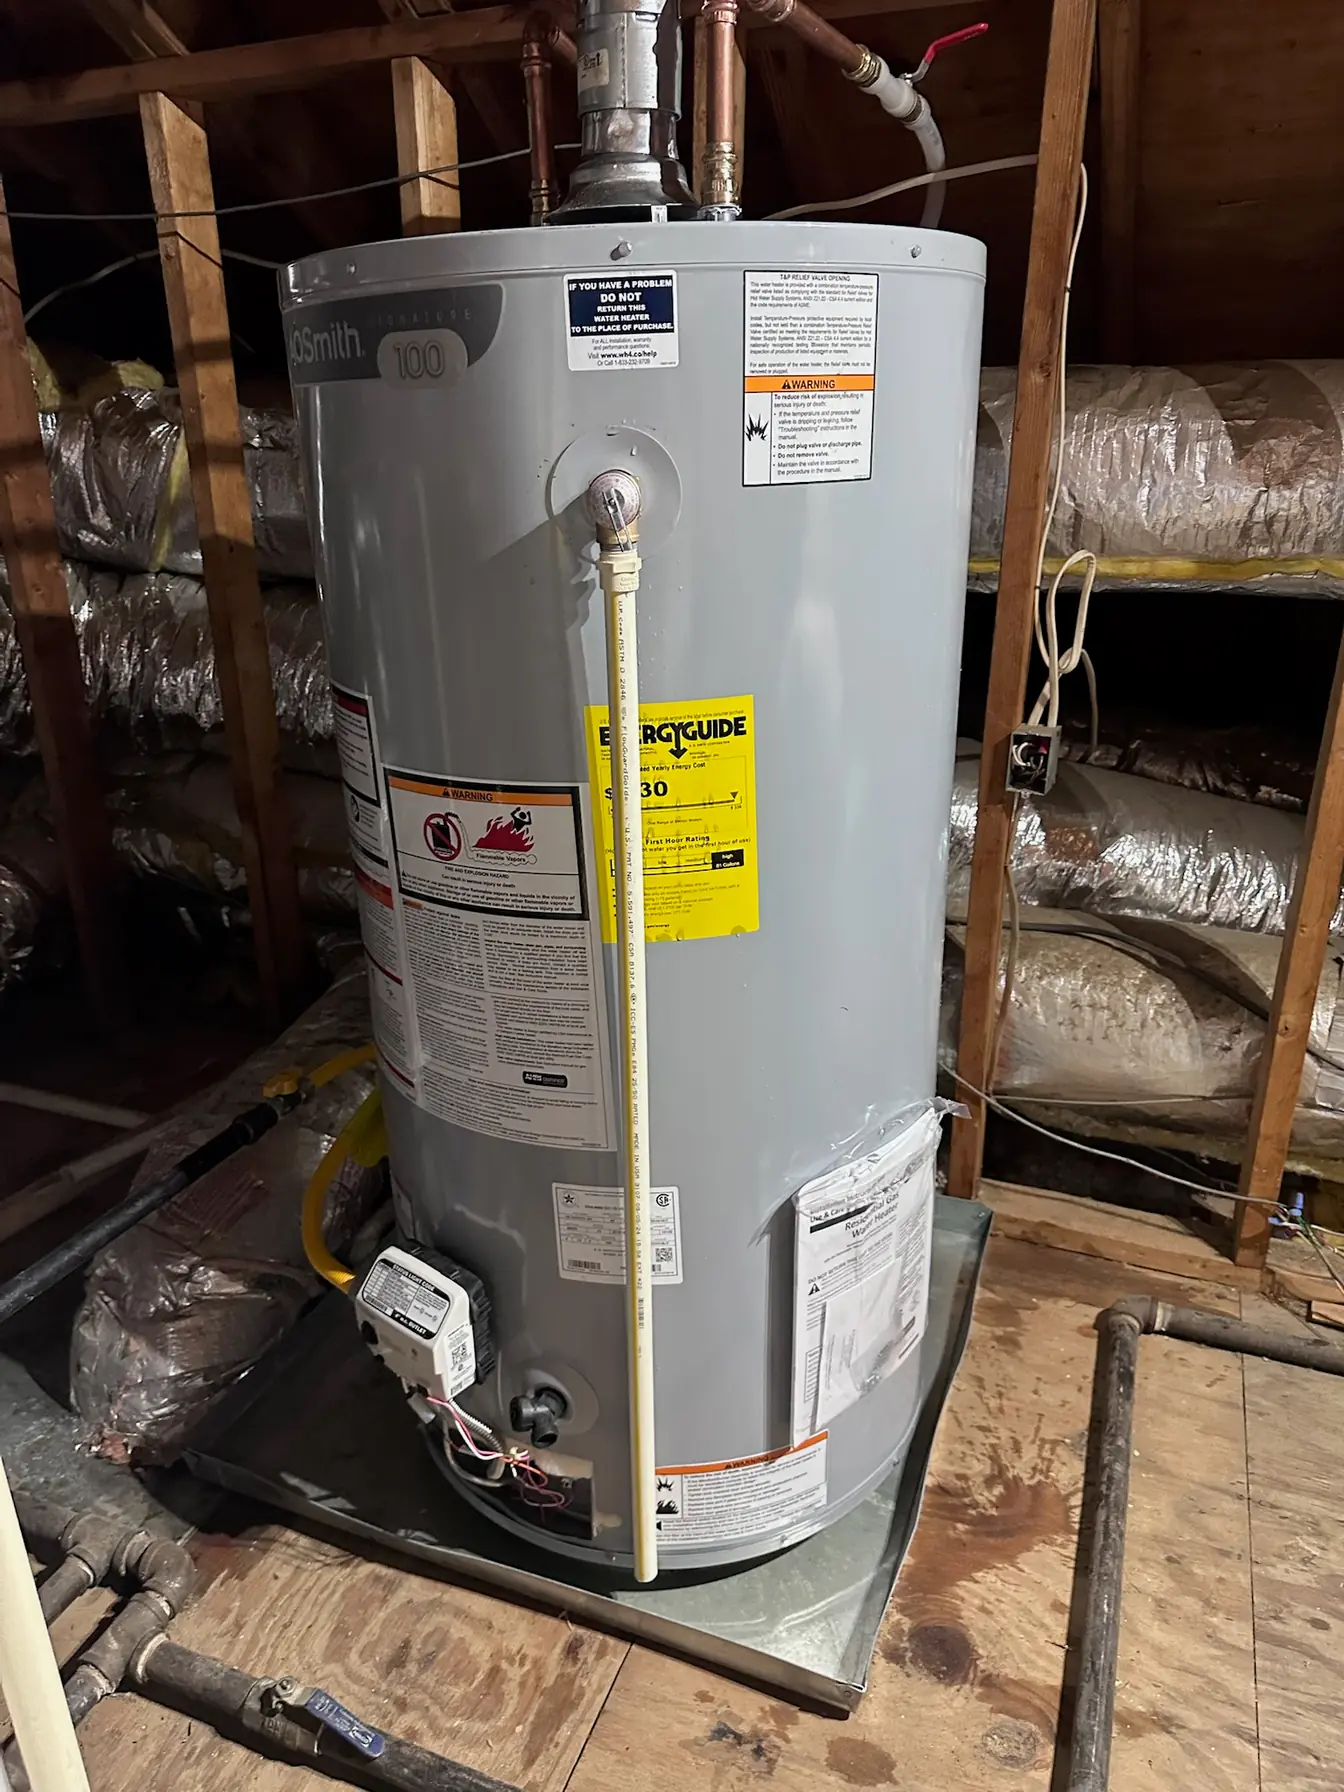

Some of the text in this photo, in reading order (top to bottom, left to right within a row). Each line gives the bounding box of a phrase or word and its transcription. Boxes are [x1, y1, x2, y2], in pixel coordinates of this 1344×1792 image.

[599, 281, 622, 289] HAVE
[632, 279, 672, 288] PROBLEM
[600, 292, 642, 302] DO NOT
[393, 341, 445, 378] 100
[792, 380, 835, 389] WARNING
[451, 789, 493, 801] WARNING
[477, 853, 526, 863] Flammable Vapors
[634, 1154, 639, 1163] IN
[886, 1192, 899, 1204] Gas
[874, 1203, 899, 1222] Heater
[409, 1321, 426, 1335] OUTLET
